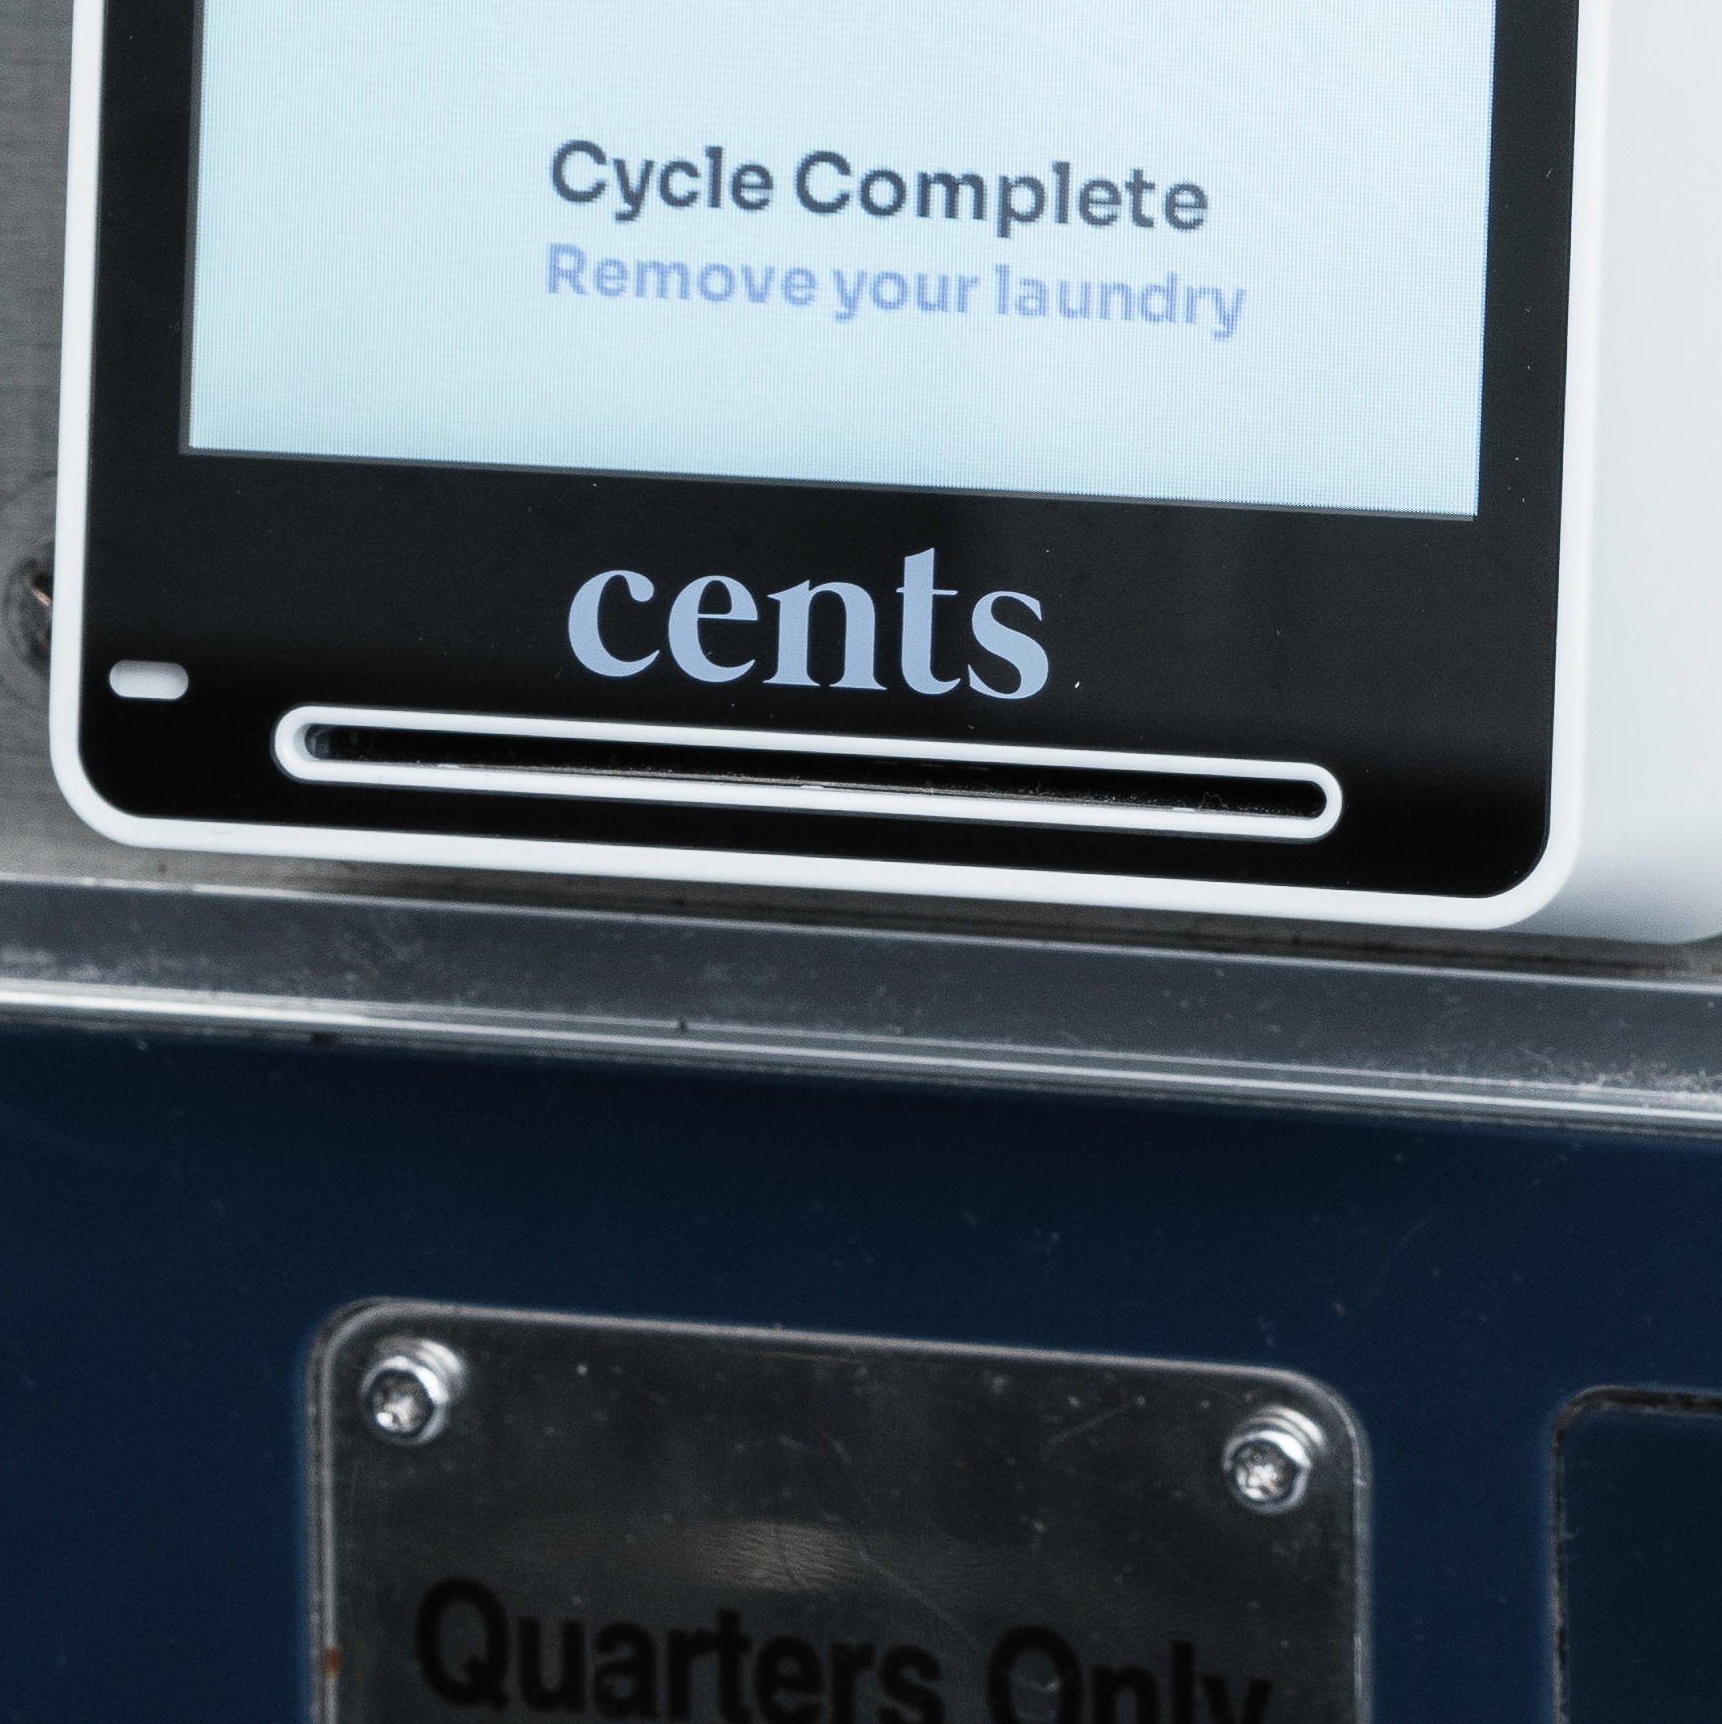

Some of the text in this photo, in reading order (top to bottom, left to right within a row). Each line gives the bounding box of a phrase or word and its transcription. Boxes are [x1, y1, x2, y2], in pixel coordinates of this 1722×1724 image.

[550, 138, 1208, 239] Cycle Complete
[546, 243, 1246, 340] Remove your laundry
[567, 547, 1051, 701] cents
[414, 1577, 945, 1724] Quarters
